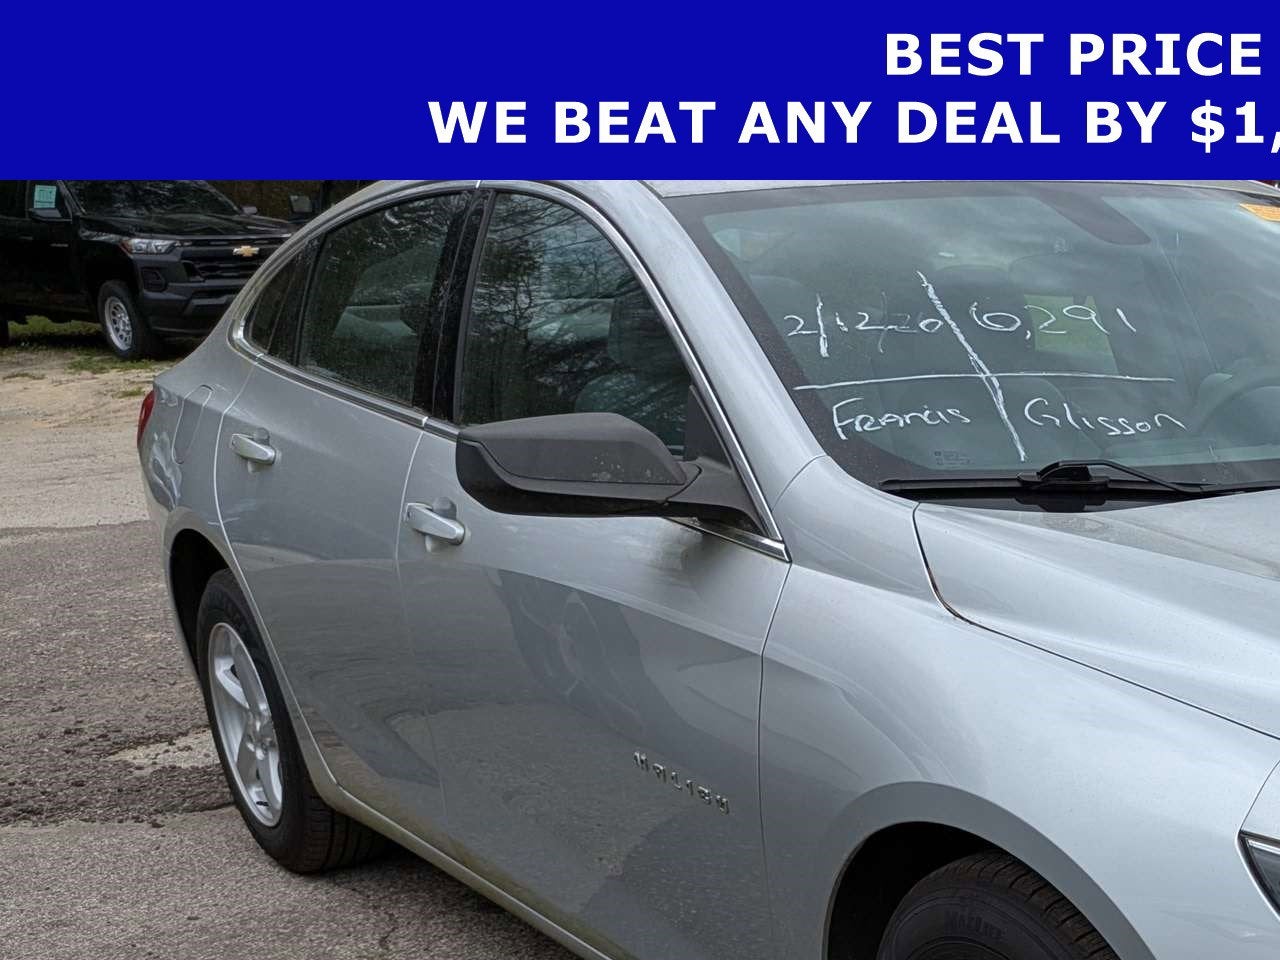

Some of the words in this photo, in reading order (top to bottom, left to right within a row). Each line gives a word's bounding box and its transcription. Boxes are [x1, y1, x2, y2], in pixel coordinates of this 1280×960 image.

[969, 302, 1136, 340] 6,291
[1024, 397, 1188, 435] Glisson
[632, 750, 730, 816] MALIBU
